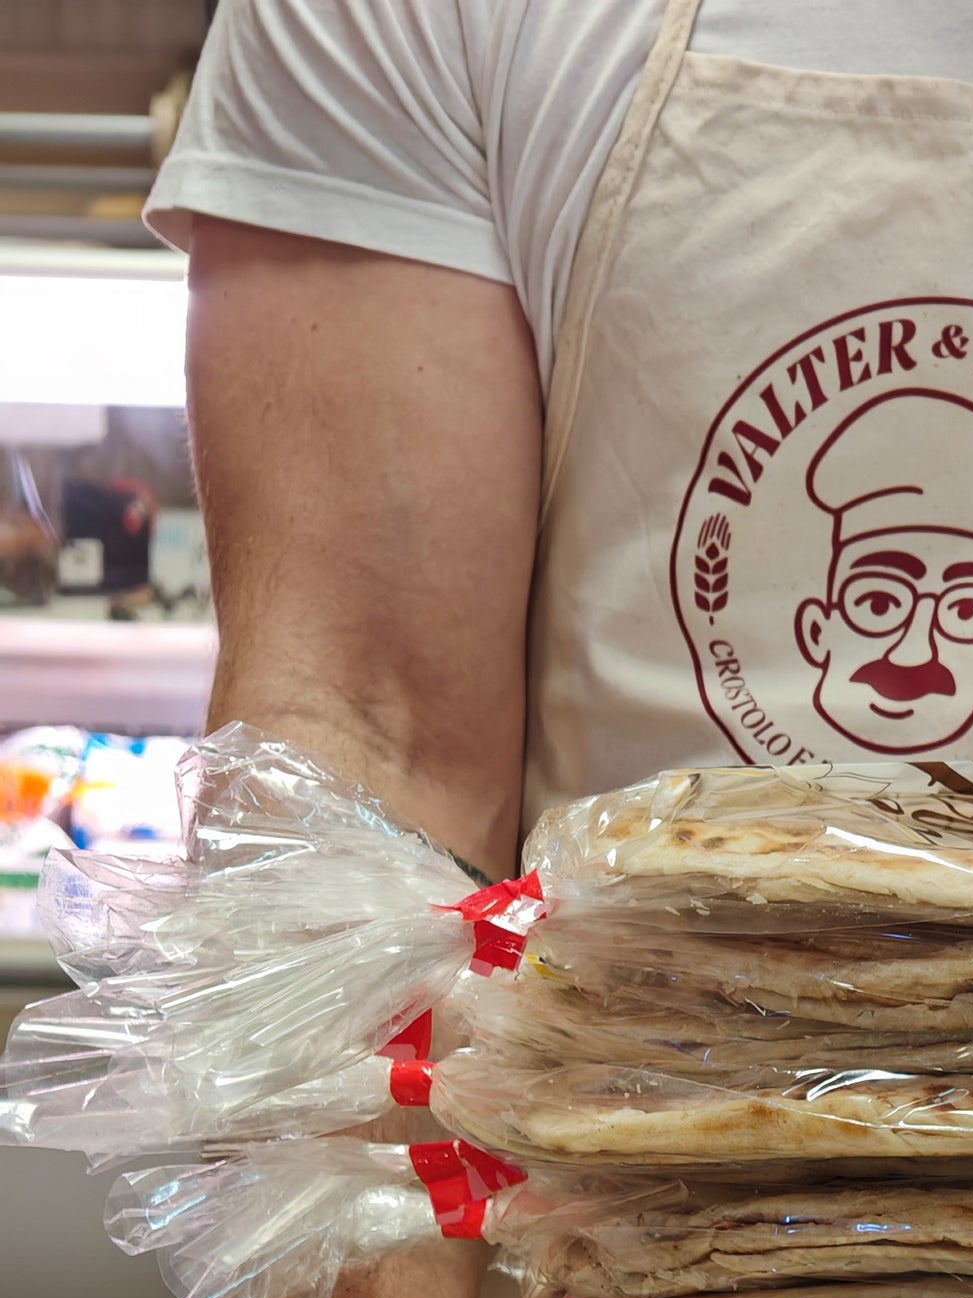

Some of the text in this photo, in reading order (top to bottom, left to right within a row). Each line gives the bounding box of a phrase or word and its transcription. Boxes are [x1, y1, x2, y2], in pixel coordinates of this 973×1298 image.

[708, 318, 918, 507] VALTER
[931, 324, 970, 360] &
[708, 639, 792, 756] CROSTOLO
